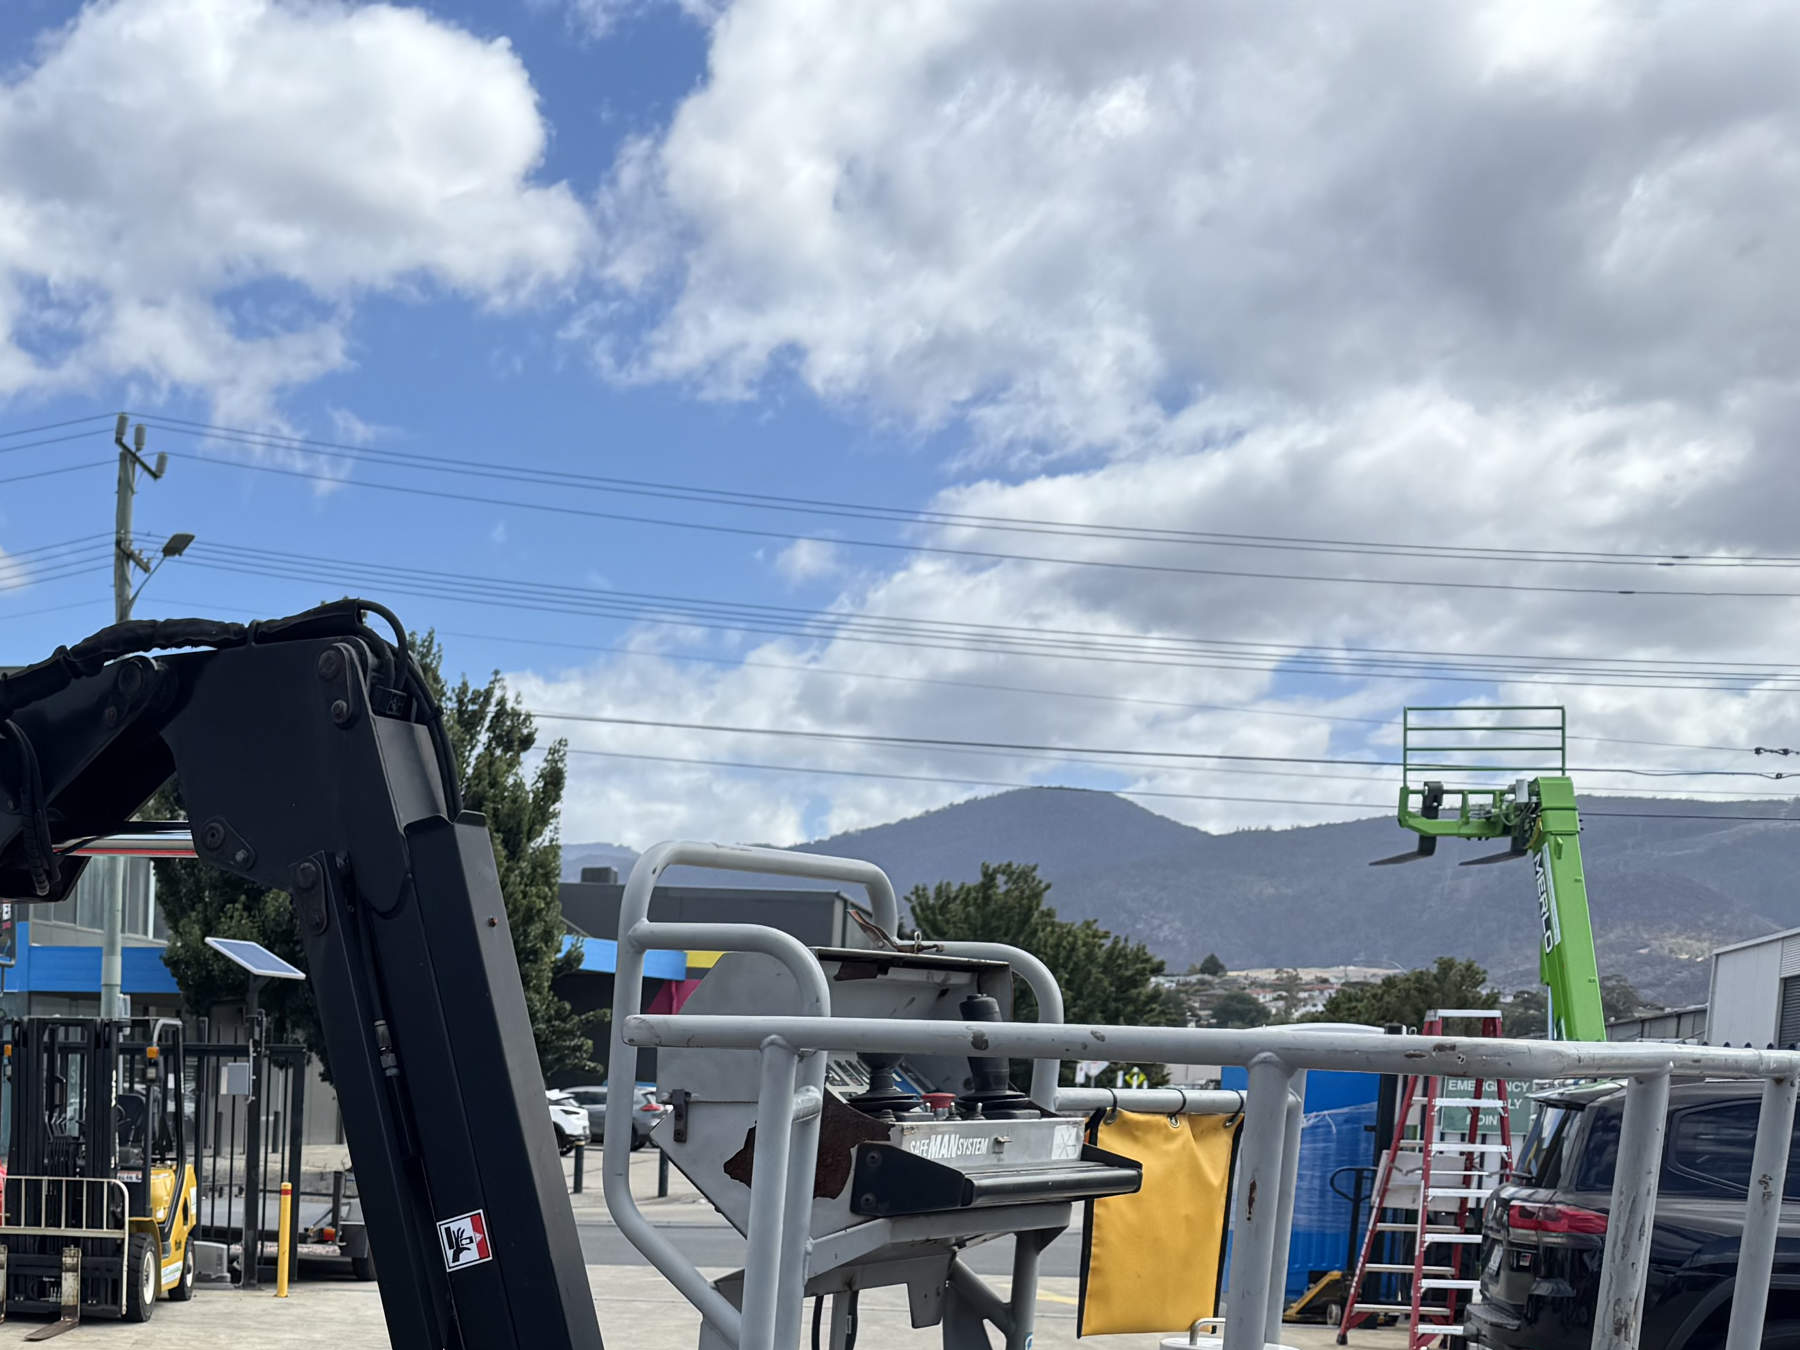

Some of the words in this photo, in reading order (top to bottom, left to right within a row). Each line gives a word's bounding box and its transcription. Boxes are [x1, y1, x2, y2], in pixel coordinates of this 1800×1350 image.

[1534, 852, 1555, 954] MERLO
[1448, 1079, 1530, 1092] EMEGNCY
[1466, 1113, 1499, 1126] OIN
